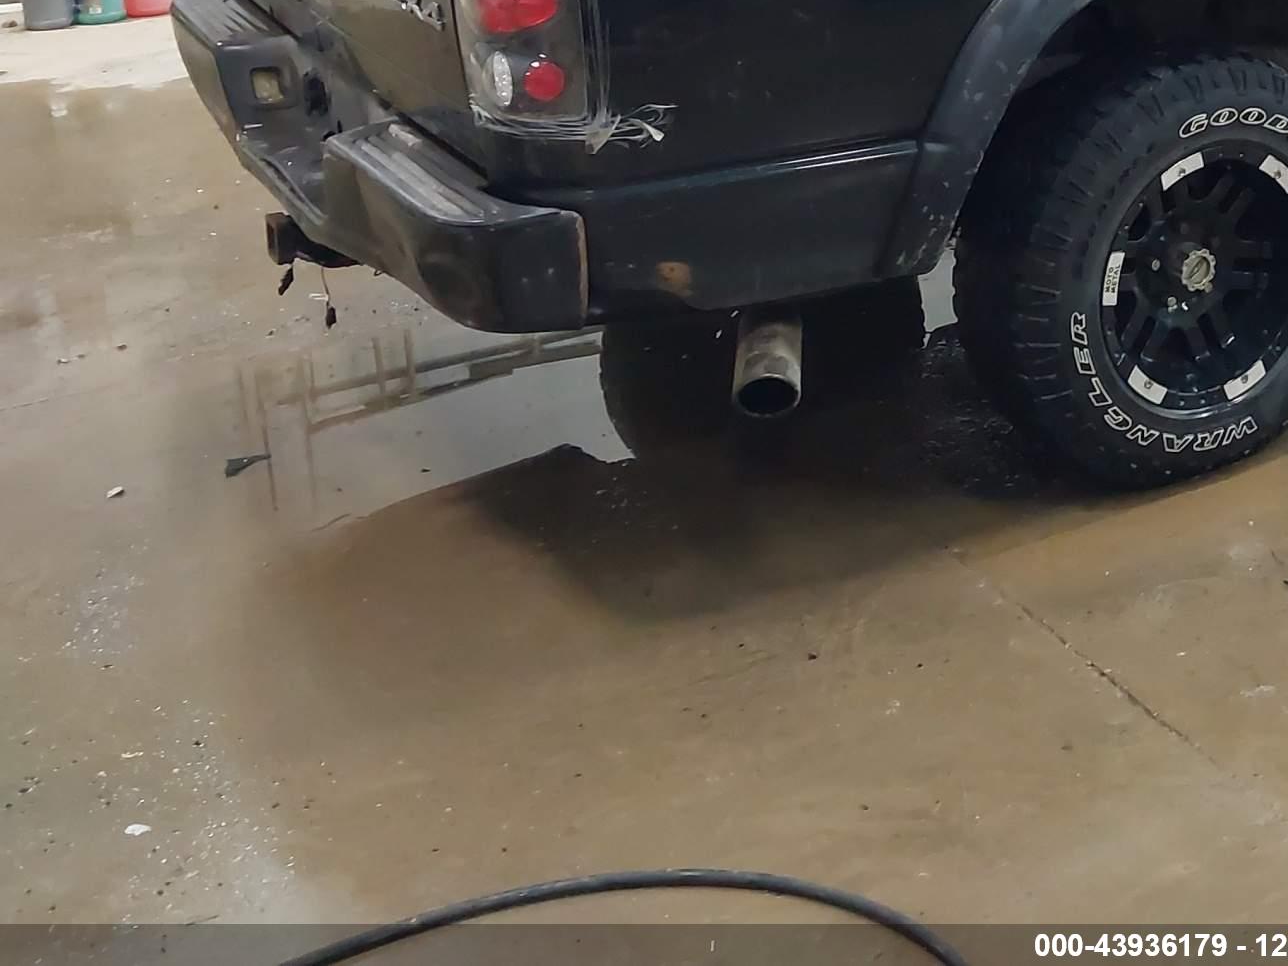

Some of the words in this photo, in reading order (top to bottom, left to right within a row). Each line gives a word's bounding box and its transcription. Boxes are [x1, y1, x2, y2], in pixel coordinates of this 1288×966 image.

[1104, 266, 1114, 293] MOTO
[1110, 263, 1121, 294] METAL
[1070, 311, 1258, 453] WRANGLER
